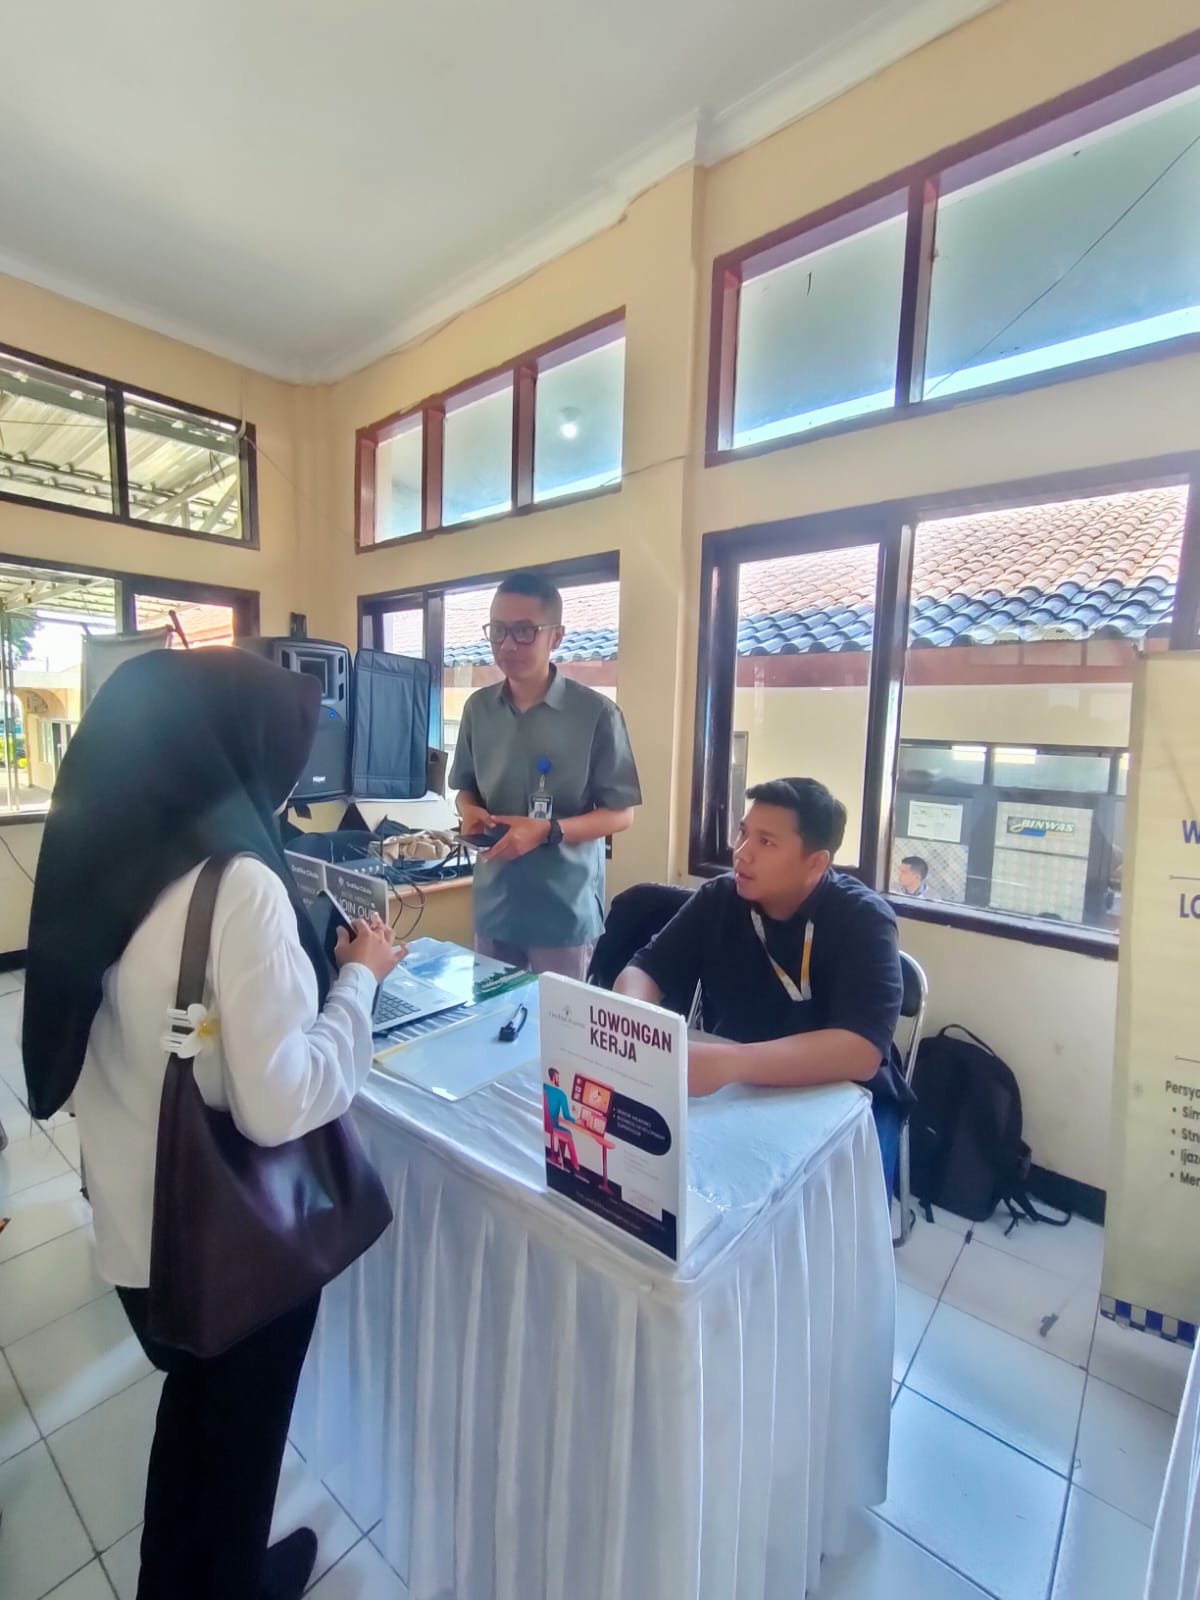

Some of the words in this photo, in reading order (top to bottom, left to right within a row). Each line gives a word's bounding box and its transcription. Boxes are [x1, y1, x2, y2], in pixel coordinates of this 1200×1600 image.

[1011, 818, 1074, 833] BINWAS
[589, 1005, 672, 1053] LOWONGAN
[590, 1027, 637, 1063] KERJA
